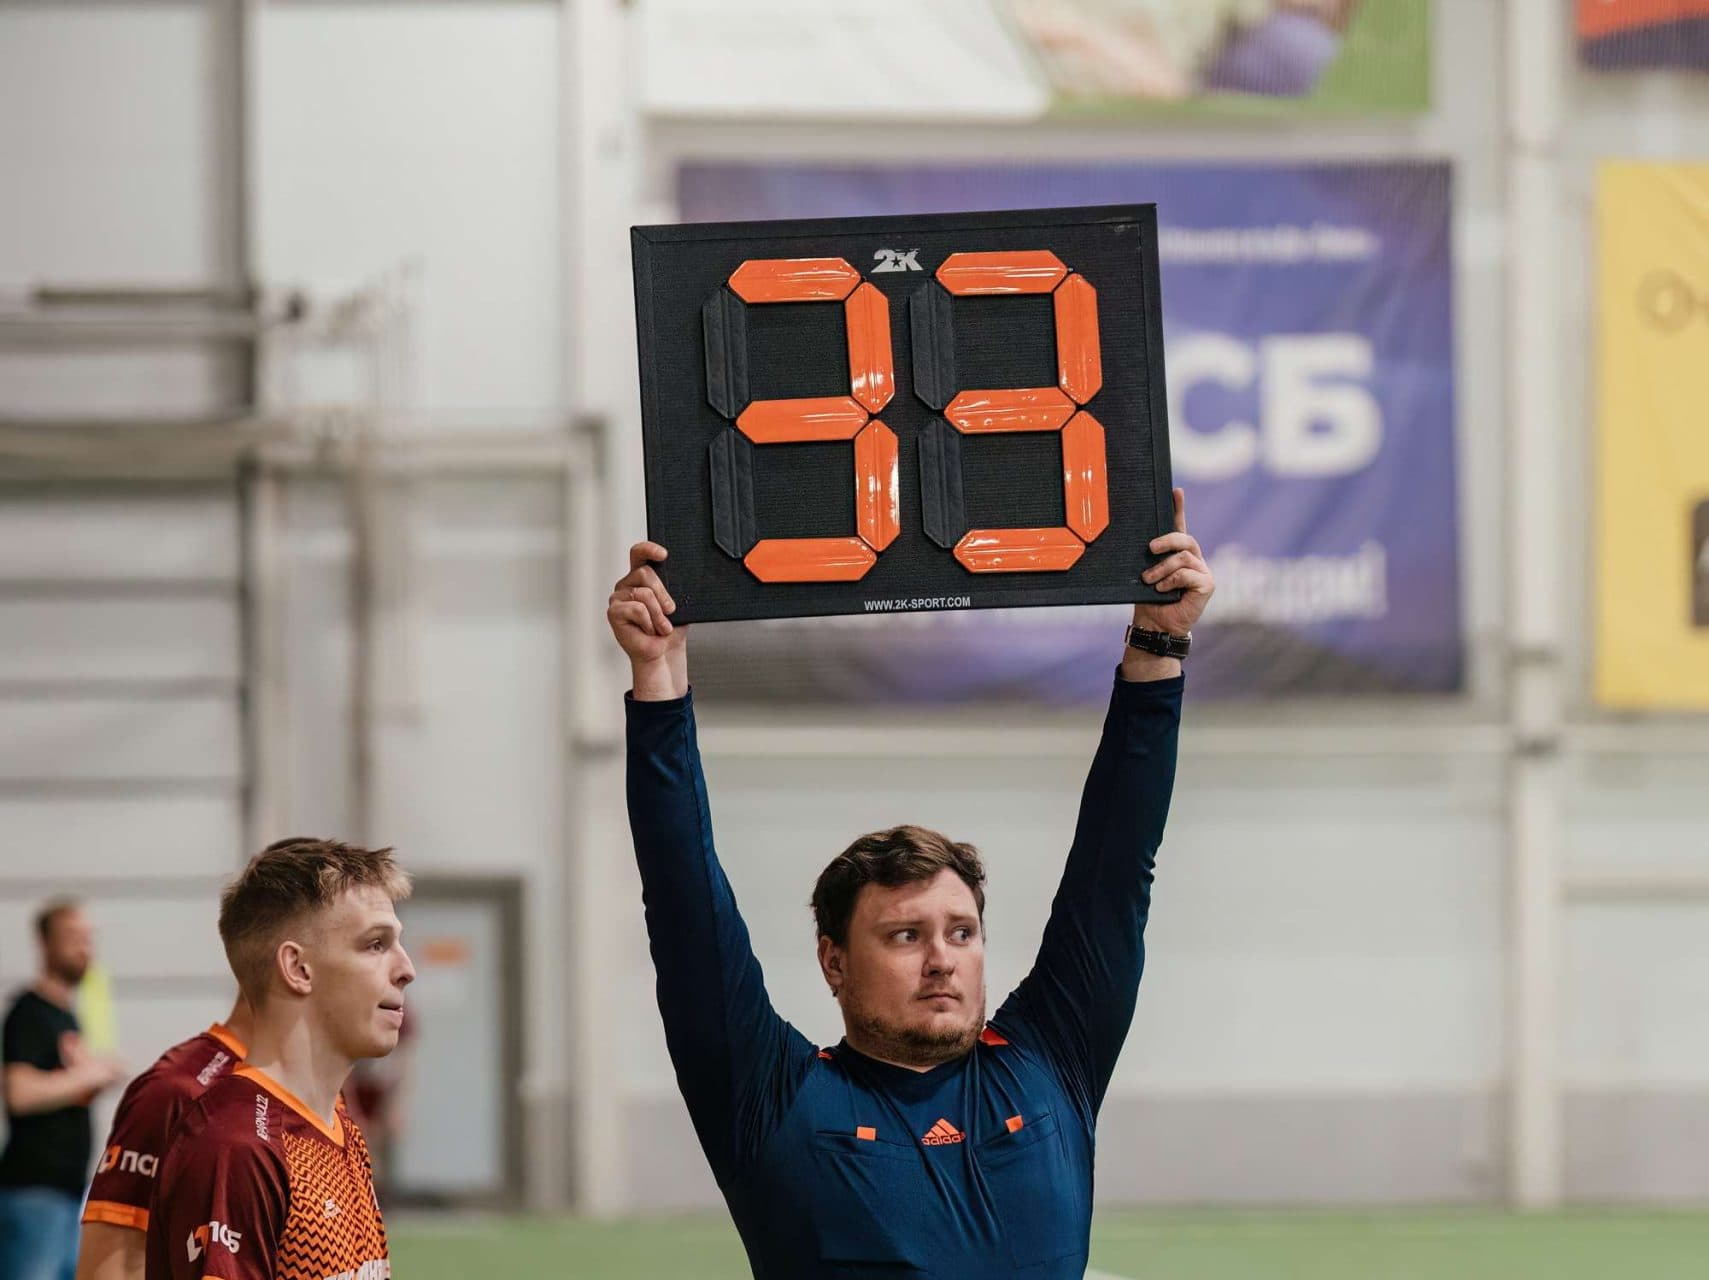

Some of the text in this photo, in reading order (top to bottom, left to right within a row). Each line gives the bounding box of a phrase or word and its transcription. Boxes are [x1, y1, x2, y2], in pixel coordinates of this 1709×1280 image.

[871, 248, 924, 273] 2K
[727, 250, 1110, 583] 33
[864, 597, 971, 611] WWW.2K-SPORT.COM
[921, 1131, 966, 1146] adidas
